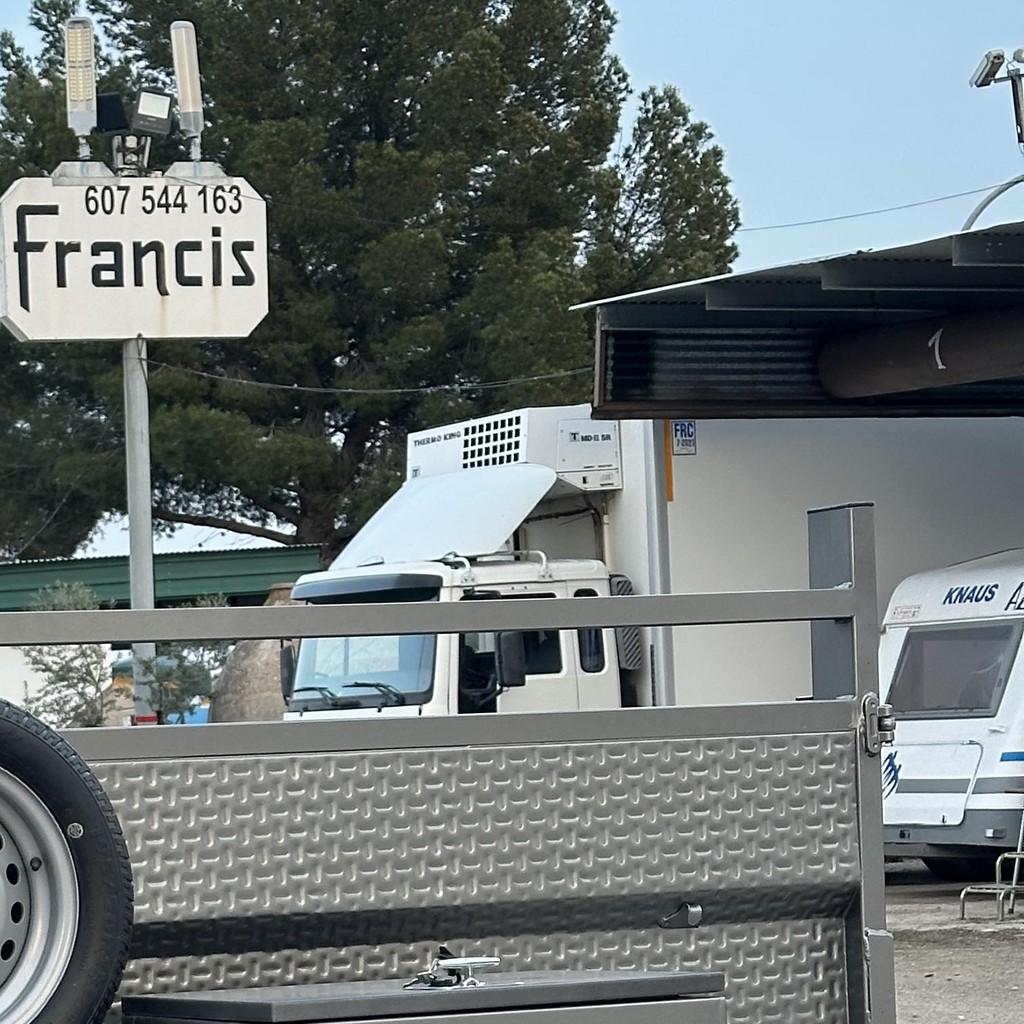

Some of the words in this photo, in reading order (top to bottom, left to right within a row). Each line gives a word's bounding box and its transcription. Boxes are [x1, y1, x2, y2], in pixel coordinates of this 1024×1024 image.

[85, 185, 131, 215] 607
[142, 185, 188, 214] 544
[198, 184, 243, 214] 163
[13, 204, 256, 313] Francis
[413, 435, 442, 447] THERMO
[443, 431, 462, 441] KING
[674, 422, 694, 438] FRC
[942, 583, 999, 605] KNAUS
